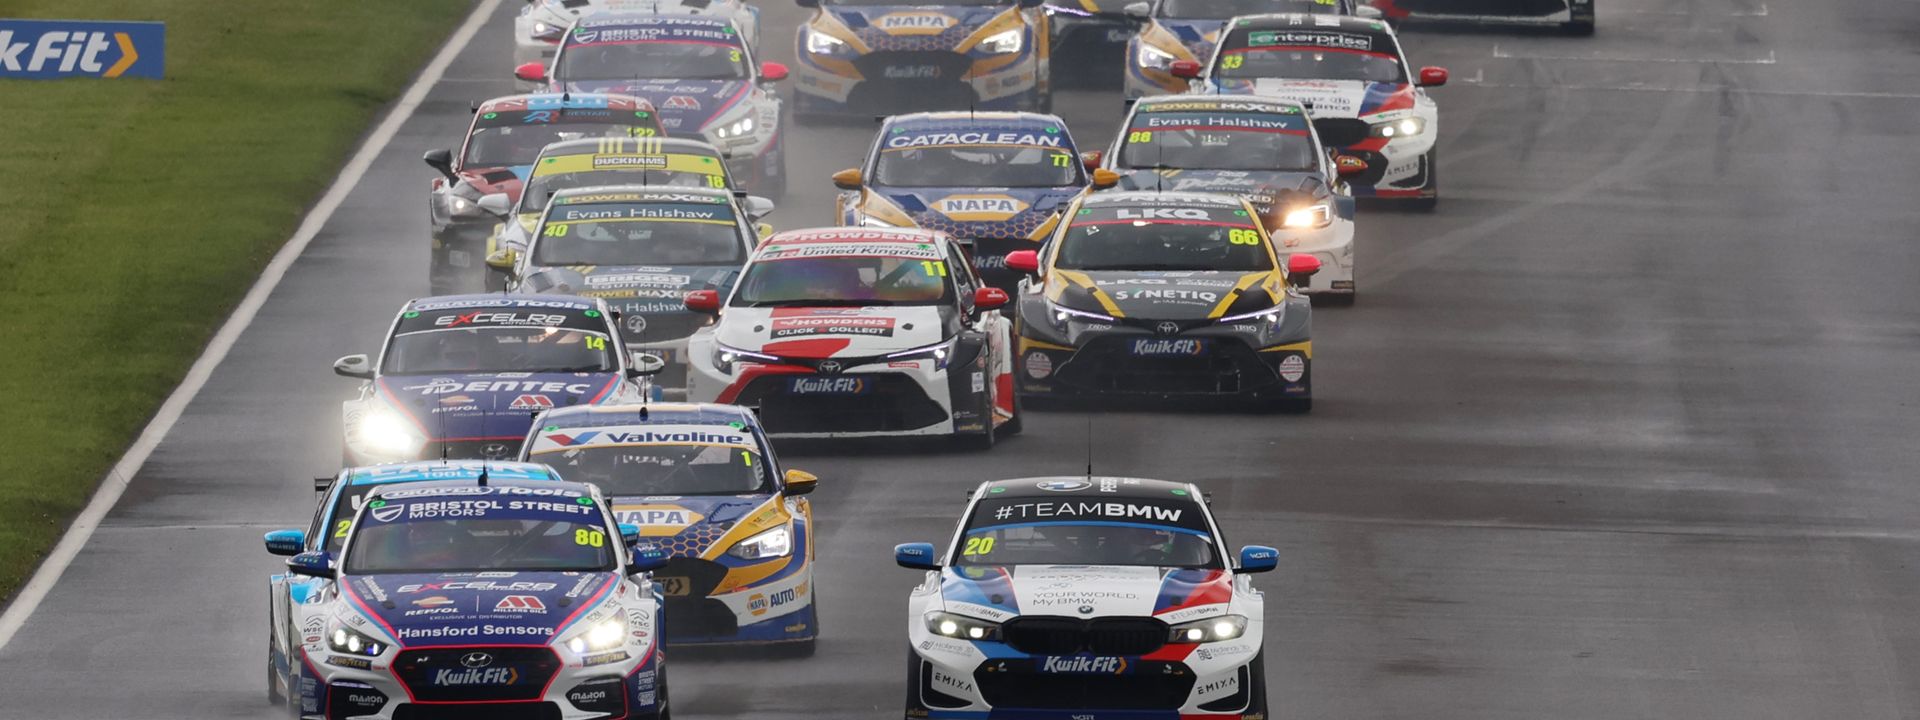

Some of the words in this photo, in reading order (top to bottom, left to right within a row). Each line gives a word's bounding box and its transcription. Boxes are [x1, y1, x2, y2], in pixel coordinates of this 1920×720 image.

[885, 16, 948, 28] NAPA
[601, 28, 666, 38] BRISTOL
[673, 28, 734, 40] STREET
[1256, 34, 1368, 46] enterprise
[729, 50, 742, 63] 3
[1221, 55, 1243, 69] 33
[1150, 103, 1218, 112] POWER
[1221, 103, 1293, 113] MAXED
[1149, 117, 1202, 129] Evans
[1208, 117, 1288, 129] Halshaw
[888, 133, 1061, 148] CATACLEAN
[1128, 131, 1153, 143] 88
[594, 157, 666, 167] DUCKHAMS
[1050, 153, 1070, 168] 77
[705, 174, 725, 189] 18
[569, 194, 640, 202] POWER
[643, 194, 719, 203] MAXED
[947, 199, 1015, 212] NAPA
[566, 209, 622, 220] Evans
[630, 208, 714, 219] Halshaw
[1116, 208, 1211, 221] LKQ
[543, 223, 569, 237] 40
[797, 231, 931, 243] HOWDENS
[1228, 229, 1260, 246] 66
[803, 247, 856, 257] United
[860, 247, 935, 259] Kingdom
[920, 260, 948, 276] 11
[1096, 278, 1168, 286] LKQ
[1116, 288, 1217, 303] SYNETIQ
[514, 299, 591, 309] Tools
[434, 310, 567, 327] EXCELR8
[796, 317, 888, 327] HOWDENS
[777, 327, 814, 337] CLICK
[828, 326, 886, 336] COLLECT
[584, 335, 606, 351] 14
[1134, 338, 1195, 356] KwikFit
[793, 376, 857, 394] KwikFit
[606, 431, 744, 445] Valvoline
[740, 450, 753, 468] 1
[495, 487, 583, 498] Tools
[409, 500, 503, 511] BRISTOL
[508, 501, 594, 515] STREET
[409, 508, 485, 519] MOTORS
[995, 502, 1183, 523] #TEAMBMW
[574, 529, 605, 548] 80
[963, 536, 996, 557] 20
[749, 600, 766, 610] NAPA
[770, 588, 795, 608] AUTO
[1033, 591, 1079, 599] YOUR
[1032, 598, 1053, 607] My
[1054, 598, 1098, 606] BMW.
[404, 607, 460, 617] REPSOL
[398, 624, 479, 639] Hansford
[482, 623, 555, 637] Sensors
[1043, 655, 1118, 673] KwikFit
[434, 667, 508, 687] KwikFit
[935, 671, 972, 692] EMIXA
[1197, 677, 1237, 695] EMIXA
